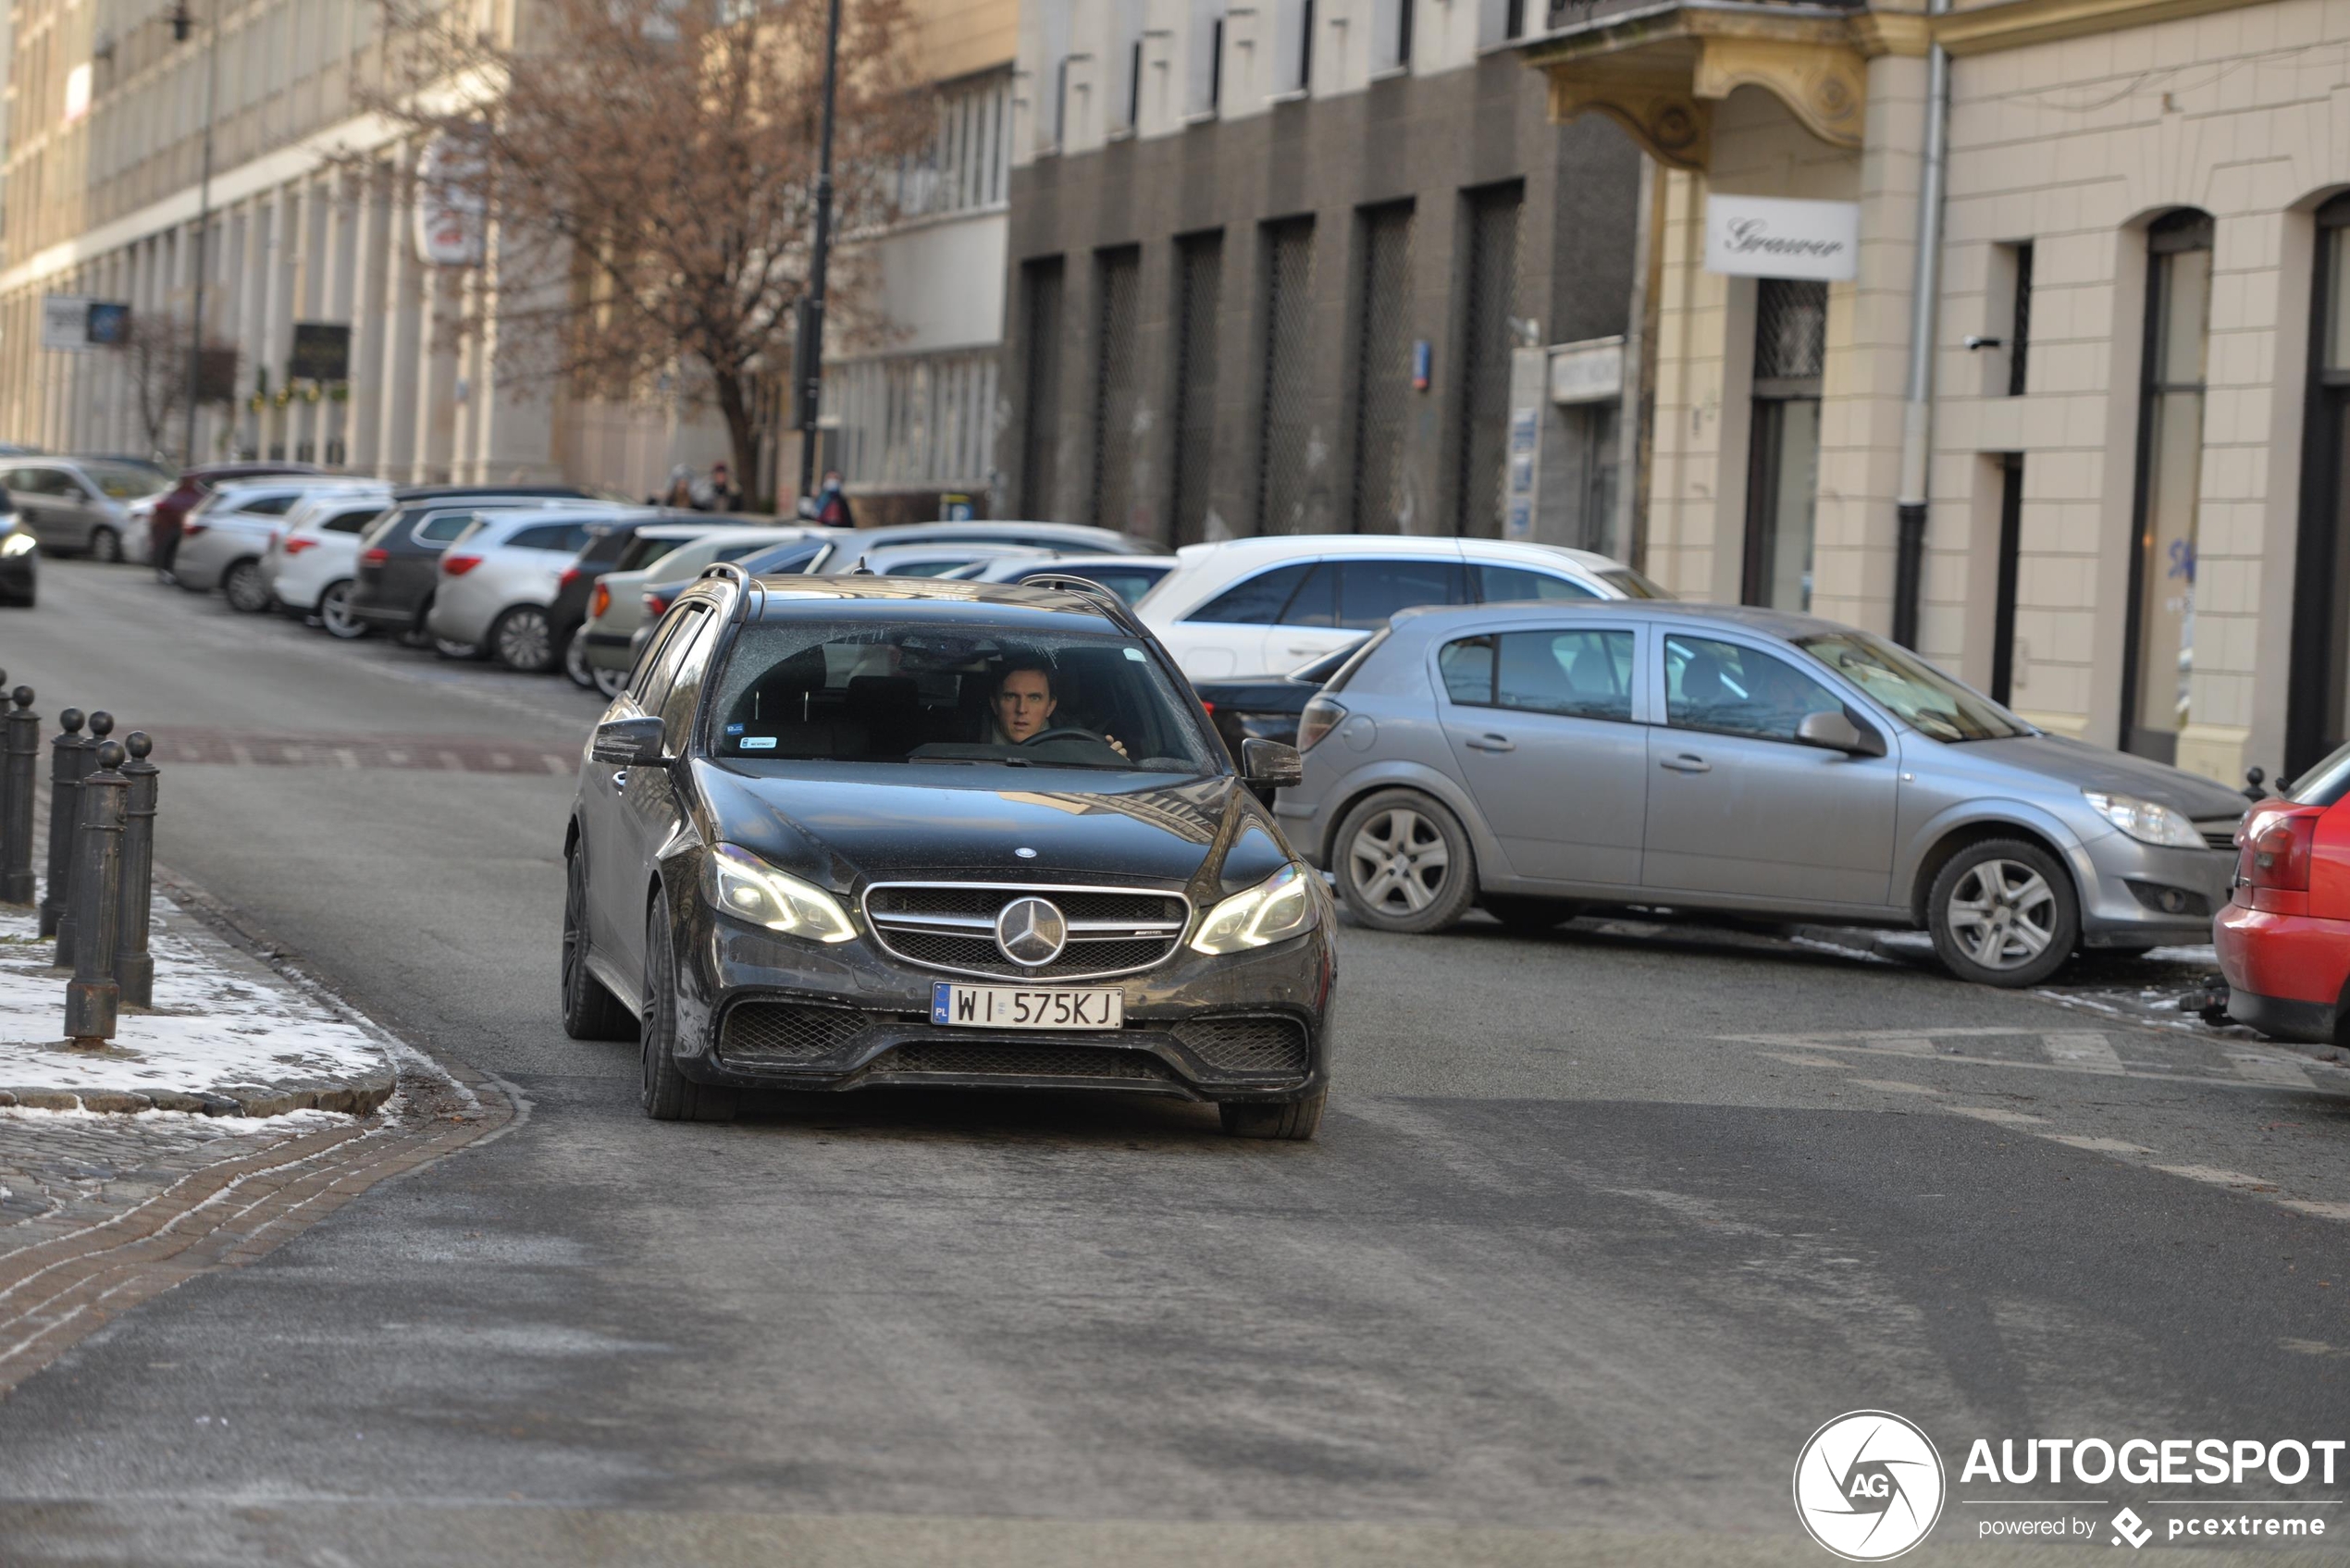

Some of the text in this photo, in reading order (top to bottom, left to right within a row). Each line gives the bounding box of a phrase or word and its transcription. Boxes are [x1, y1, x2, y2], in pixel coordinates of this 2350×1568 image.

[935, 1007, 947, 1018] PL
[958, 990, 1110, 1025] WI 575KJ
